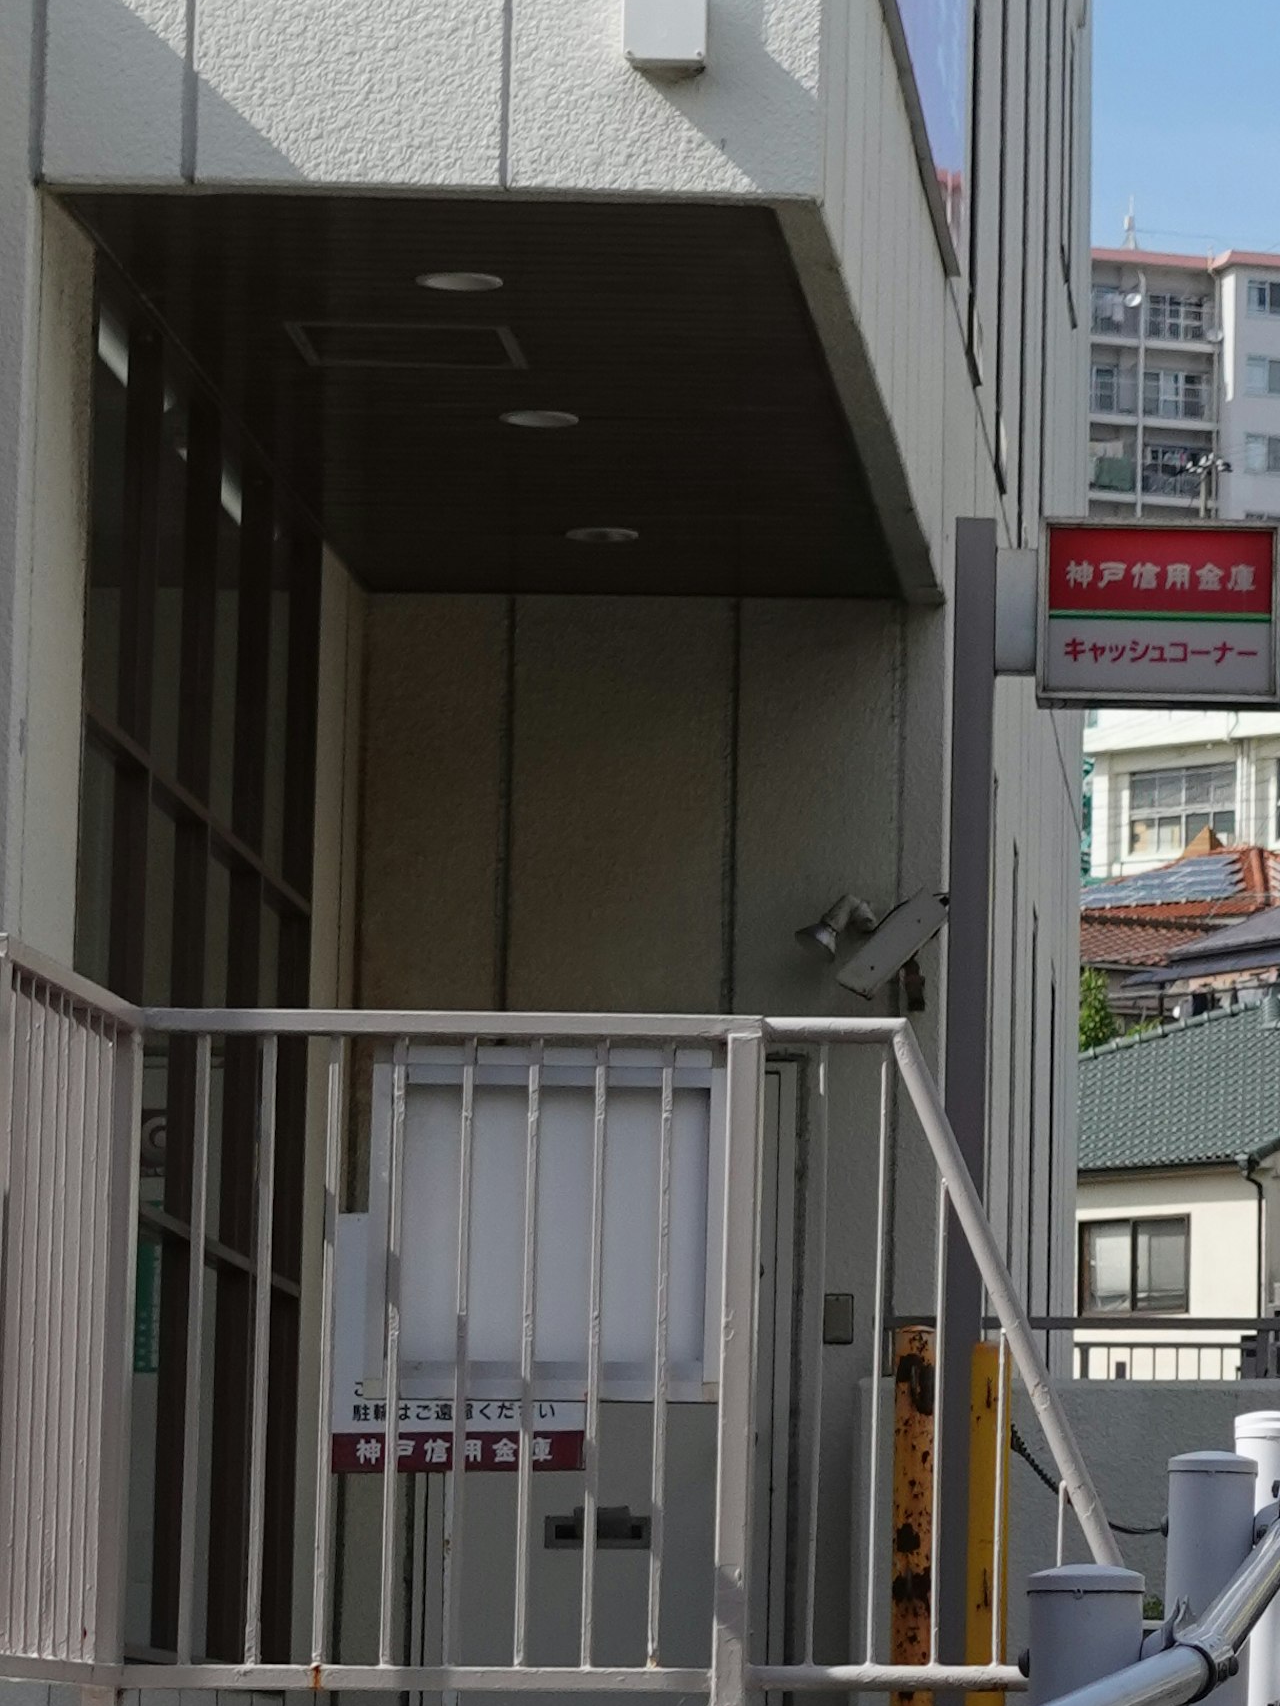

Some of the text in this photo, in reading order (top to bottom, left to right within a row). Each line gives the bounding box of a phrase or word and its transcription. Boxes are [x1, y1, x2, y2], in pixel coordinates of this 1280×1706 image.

[1066, 560, 1256, 591] 神戸信用金庫
[1064, 638, 1258, 665] キャッシュコーナー
